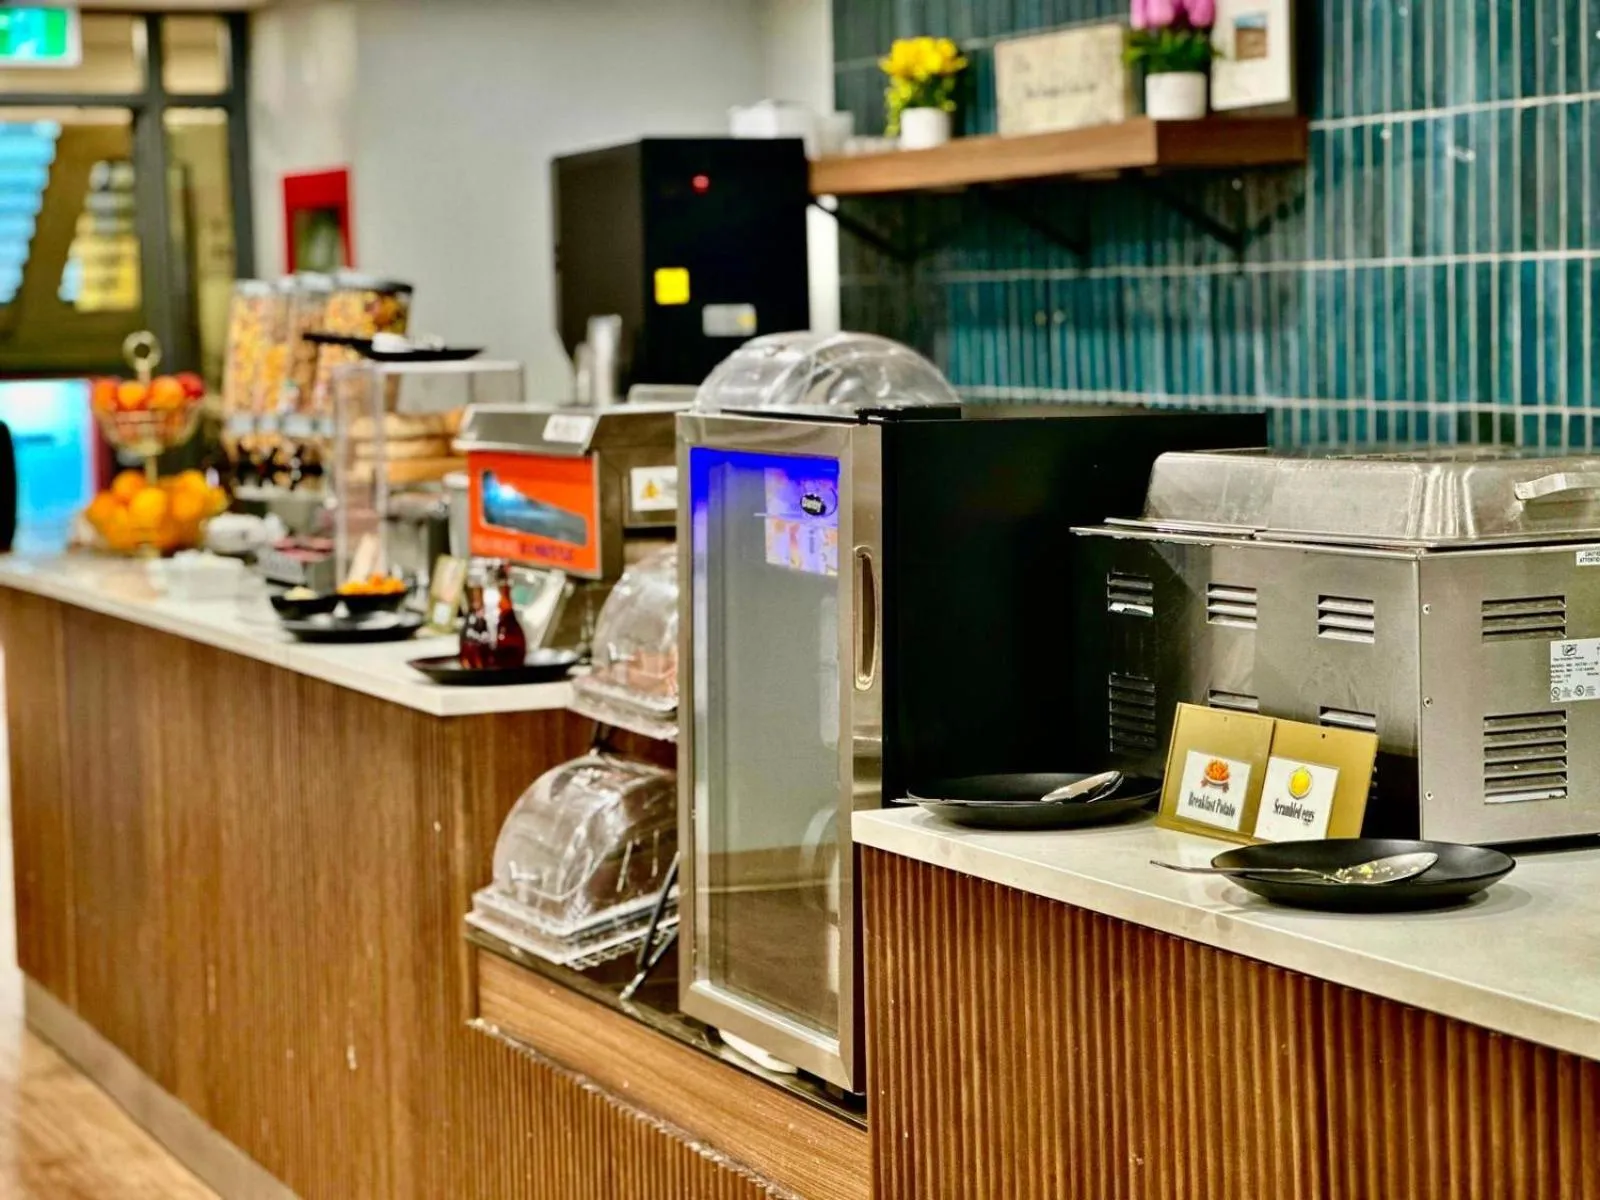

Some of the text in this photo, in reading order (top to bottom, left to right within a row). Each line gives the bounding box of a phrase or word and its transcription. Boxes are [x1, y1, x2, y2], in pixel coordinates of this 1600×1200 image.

[1188, 791, 1236, 816] Breakfast Potato
[1273, 798, 1315, 825] Scrambled eggs
